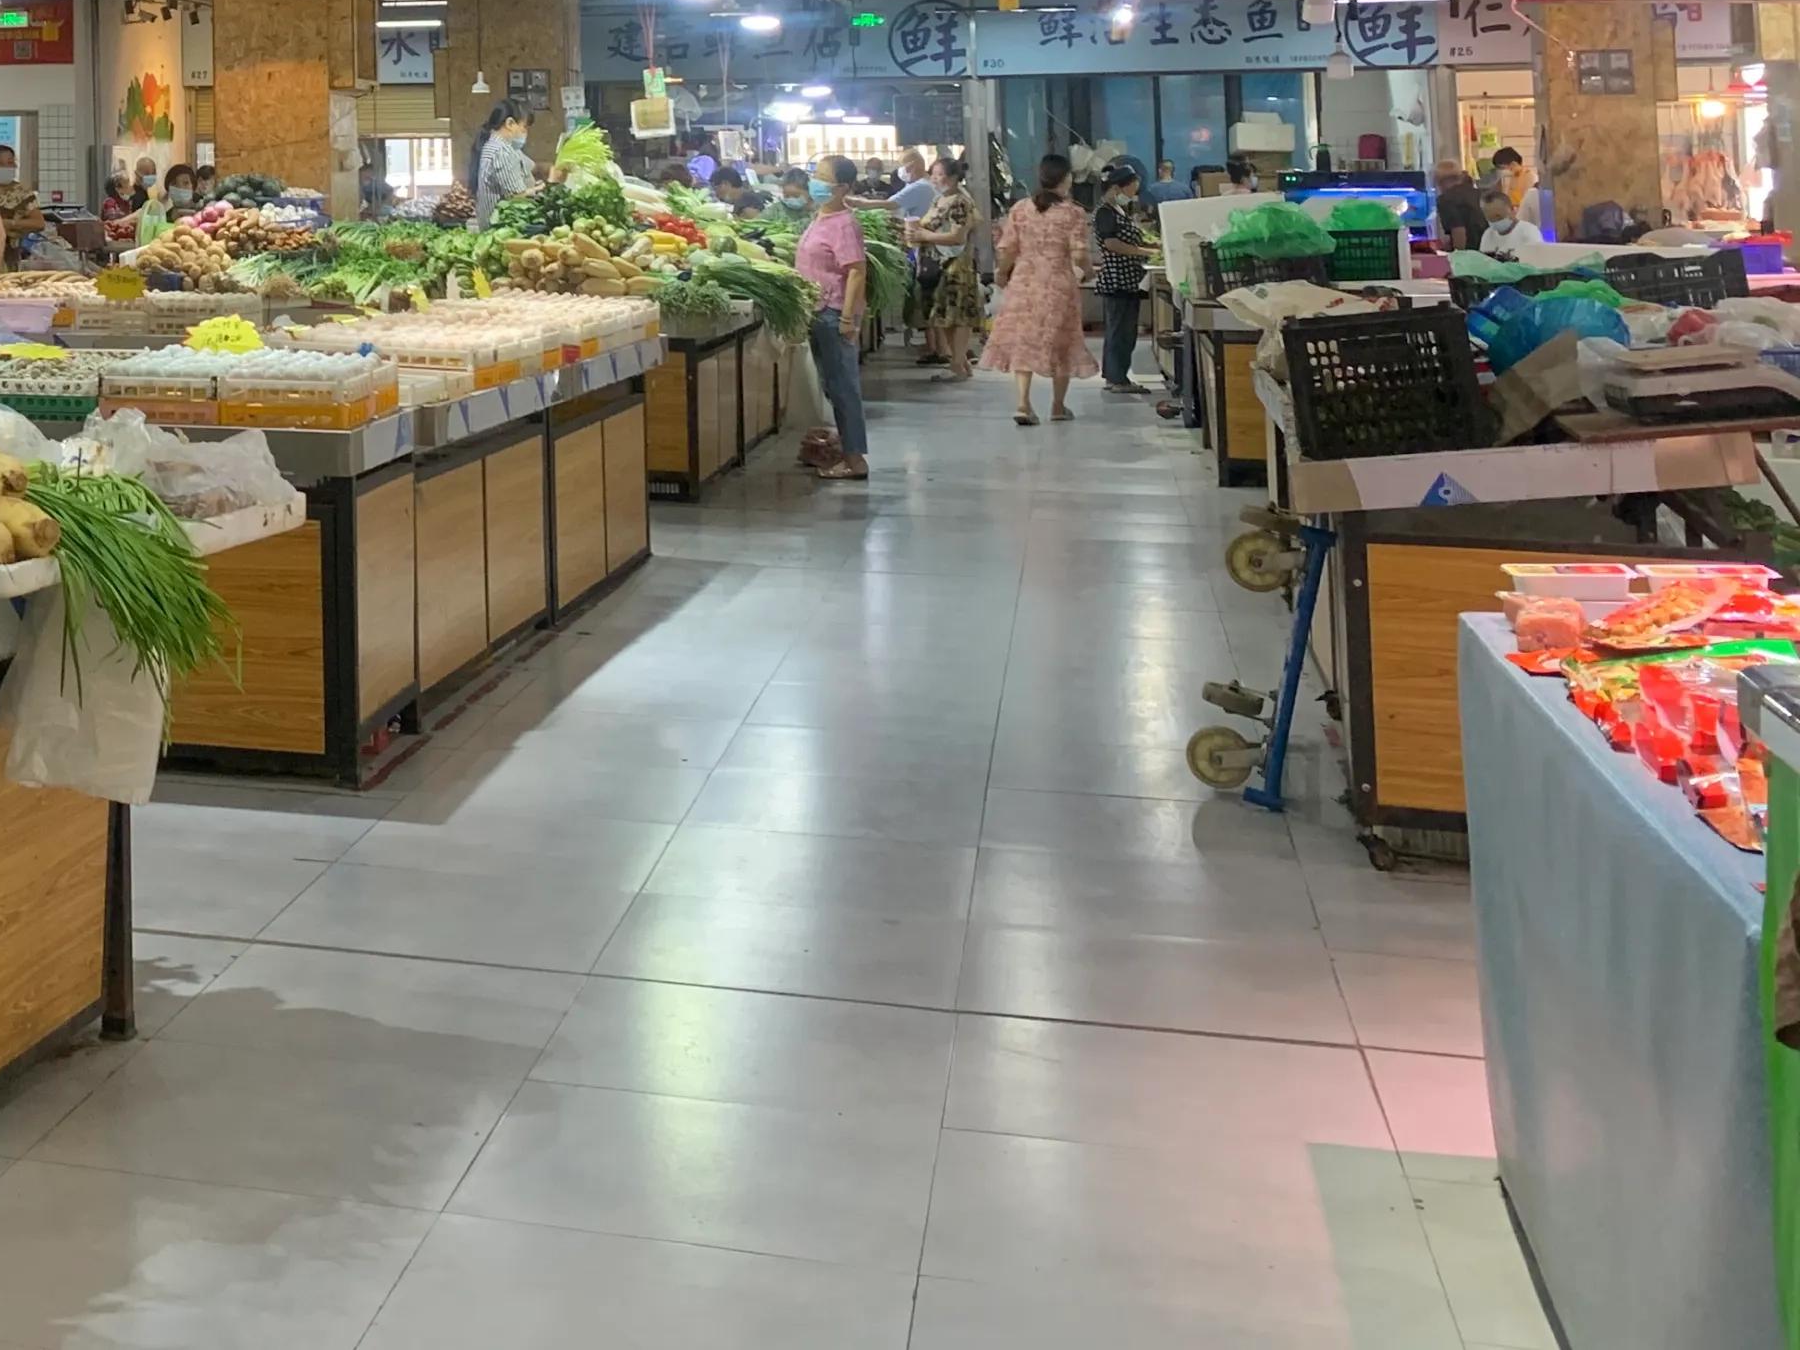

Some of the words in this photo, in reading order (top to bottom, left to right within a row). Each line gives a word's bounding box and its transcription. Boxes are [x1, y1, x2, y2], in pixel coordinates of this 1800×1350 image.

[380, 32, 421, 65] 水
[895, 6, 967, 74] 鲜
[1353, 3, 1437, 64] 鲜
